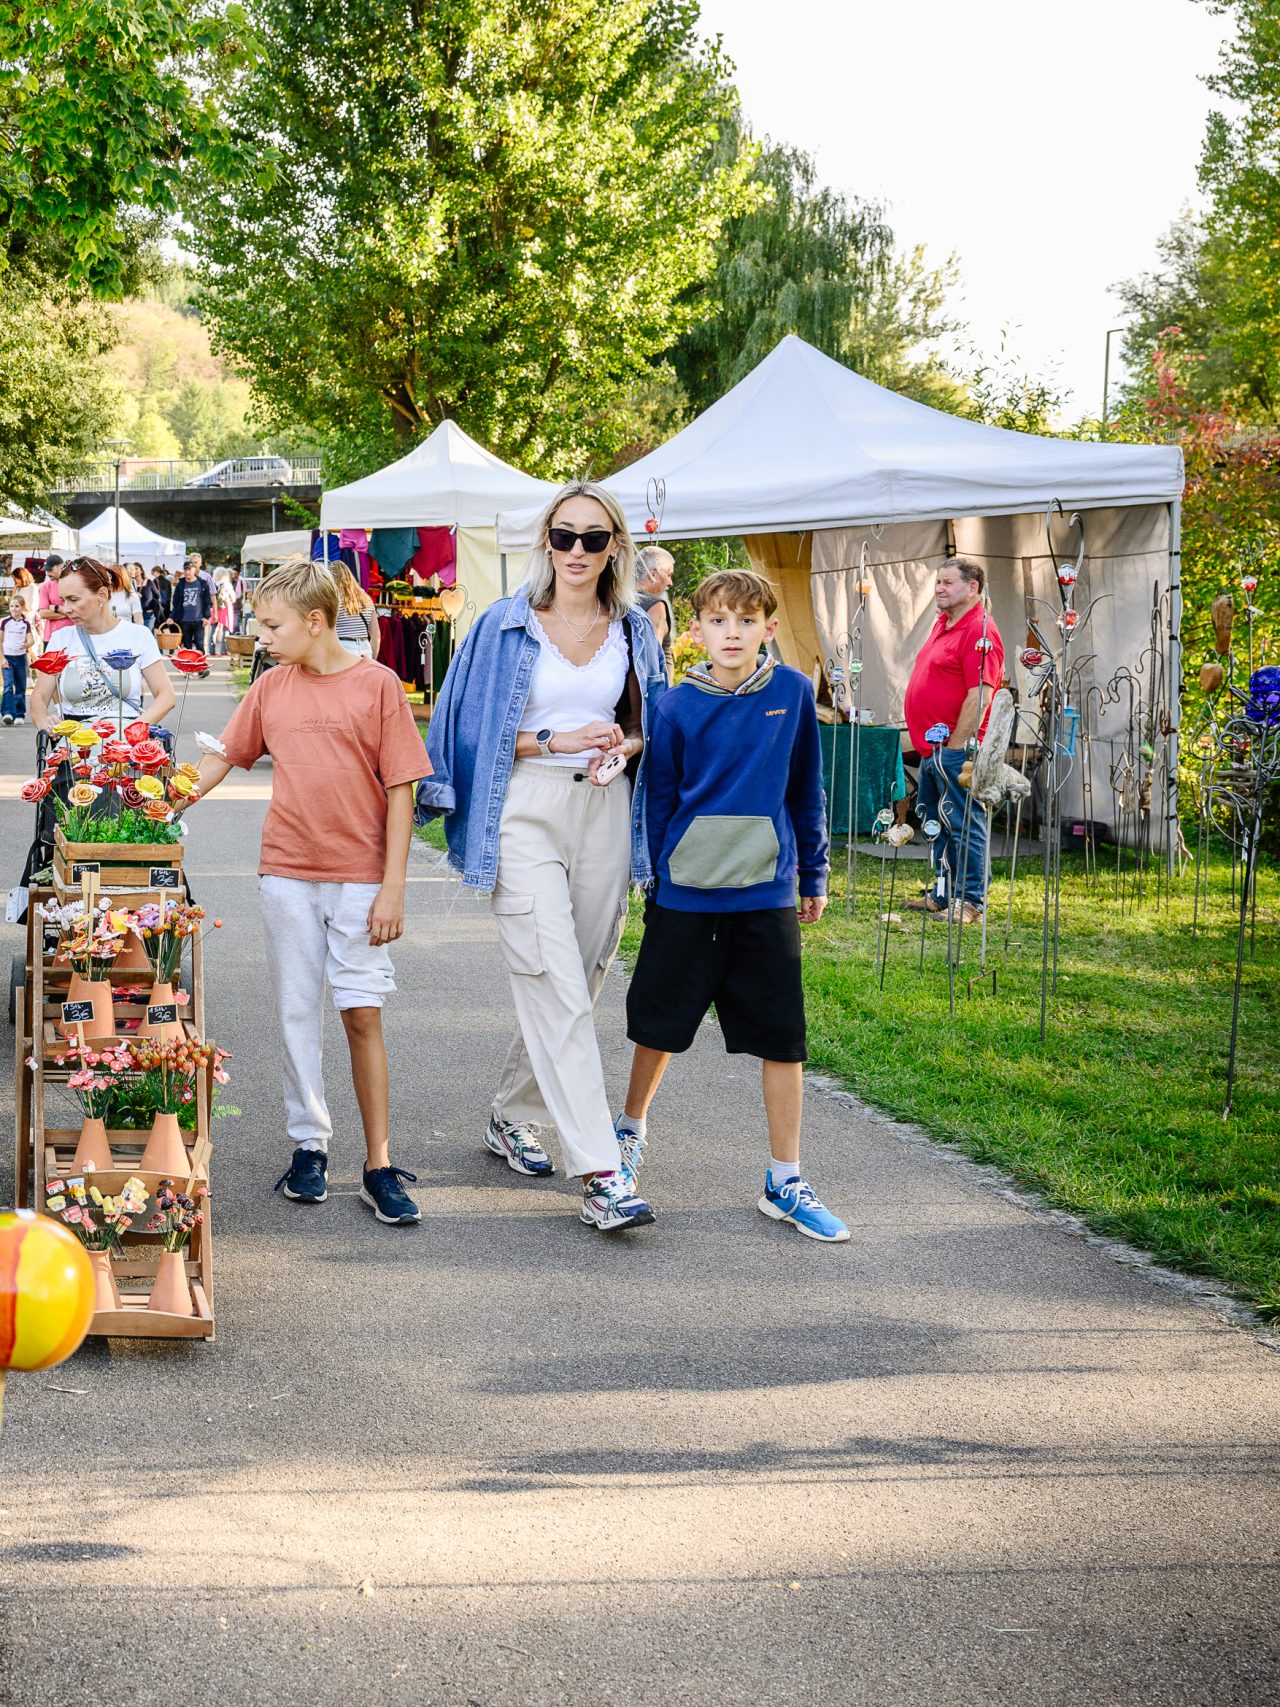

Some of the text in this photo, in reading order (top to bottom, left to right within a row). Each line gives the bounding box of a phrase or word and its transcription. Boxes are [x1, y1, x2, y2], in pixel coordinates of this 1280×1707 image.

[155, 875, 174, 886] 3€
[71, 1009, 90, 1021] 3€
[153, 1012, 173, 1023] 3€
